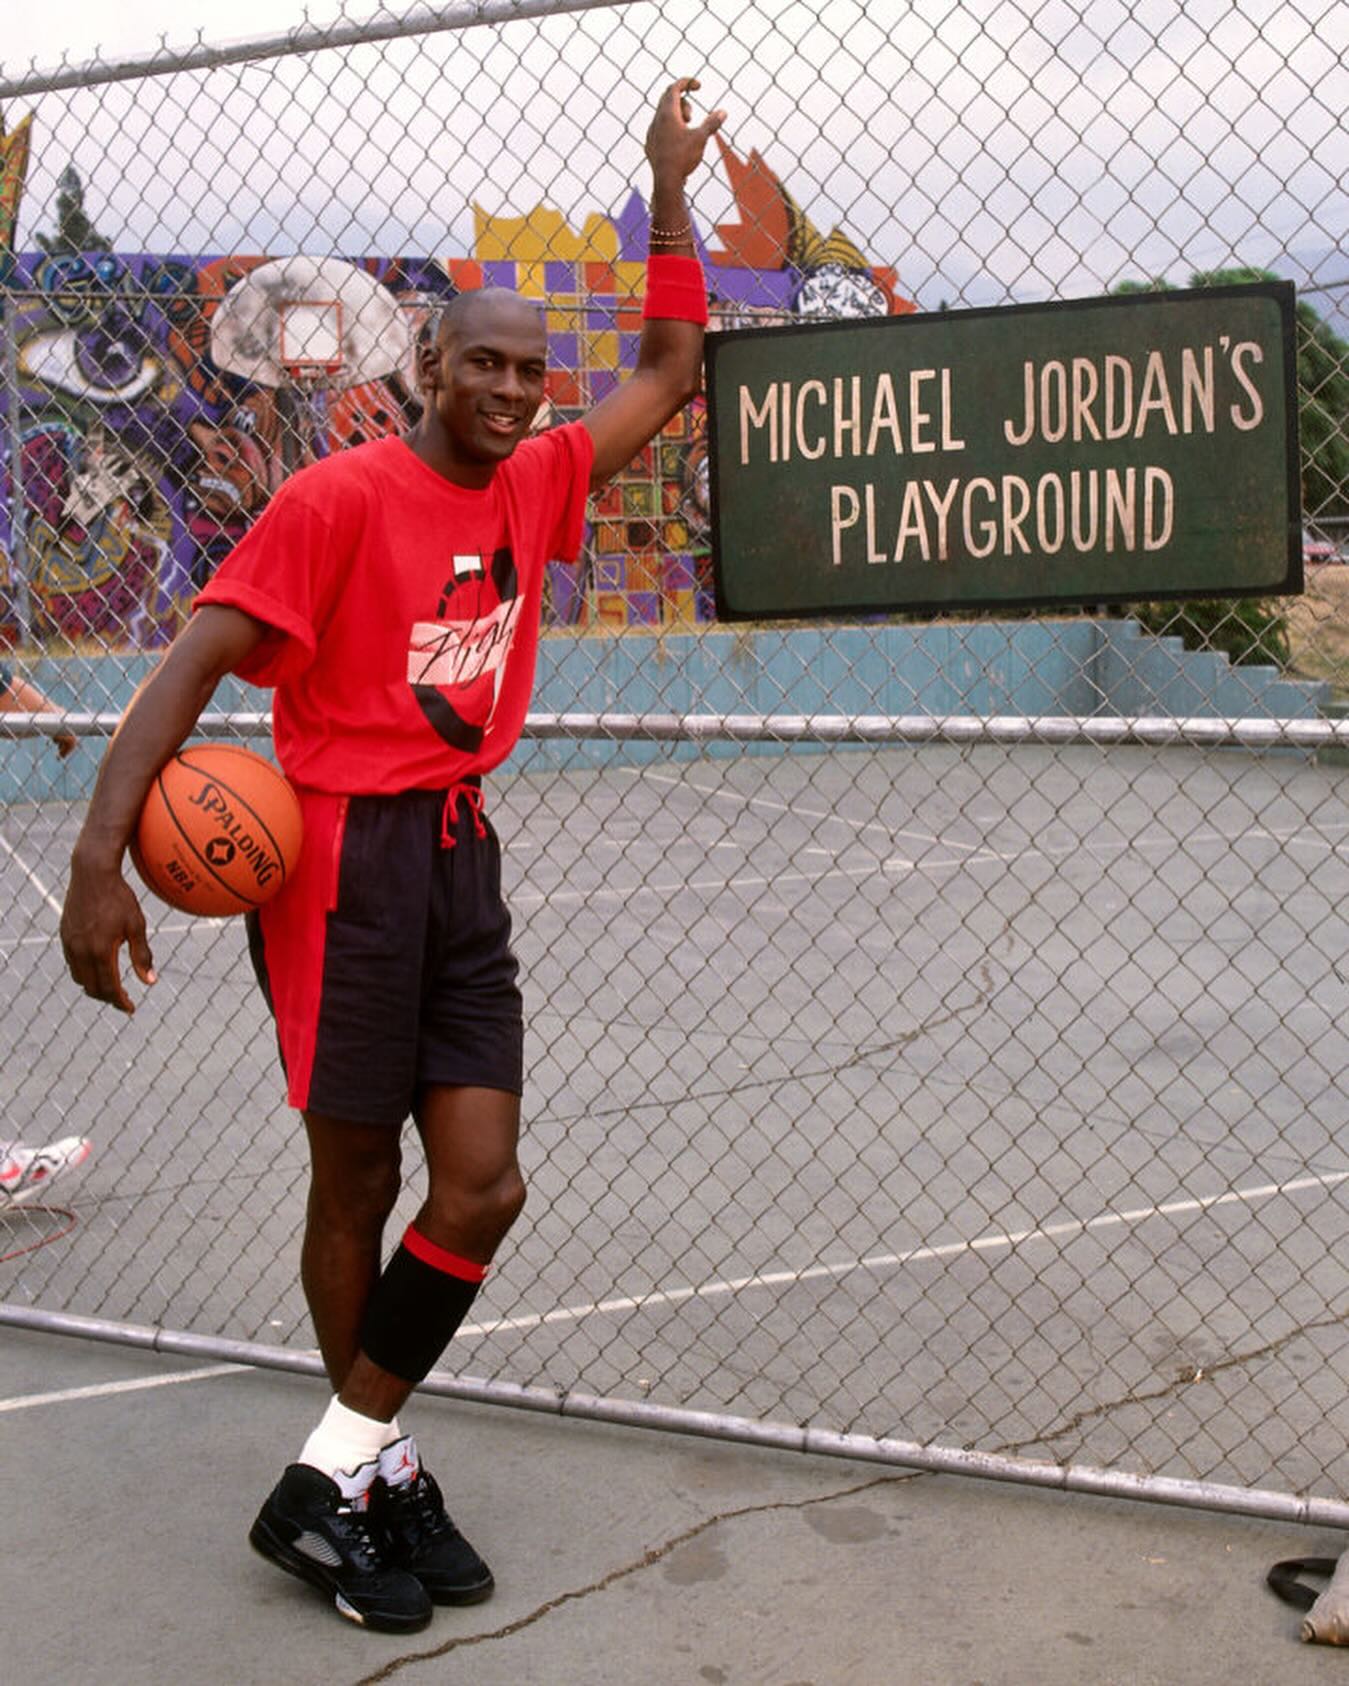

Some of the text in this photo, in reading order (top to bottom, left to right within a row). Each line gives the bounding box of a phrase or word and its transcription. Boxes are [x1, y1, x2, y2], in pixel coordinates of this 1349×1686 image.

[739, 335, 1265, 465] MICHAEL JORDAN'S
[830, 465, 1175, 566] PLAYGROUND
[166, 860, 195, 892] NBA
[188, 783, 279, 887] SPALDING
